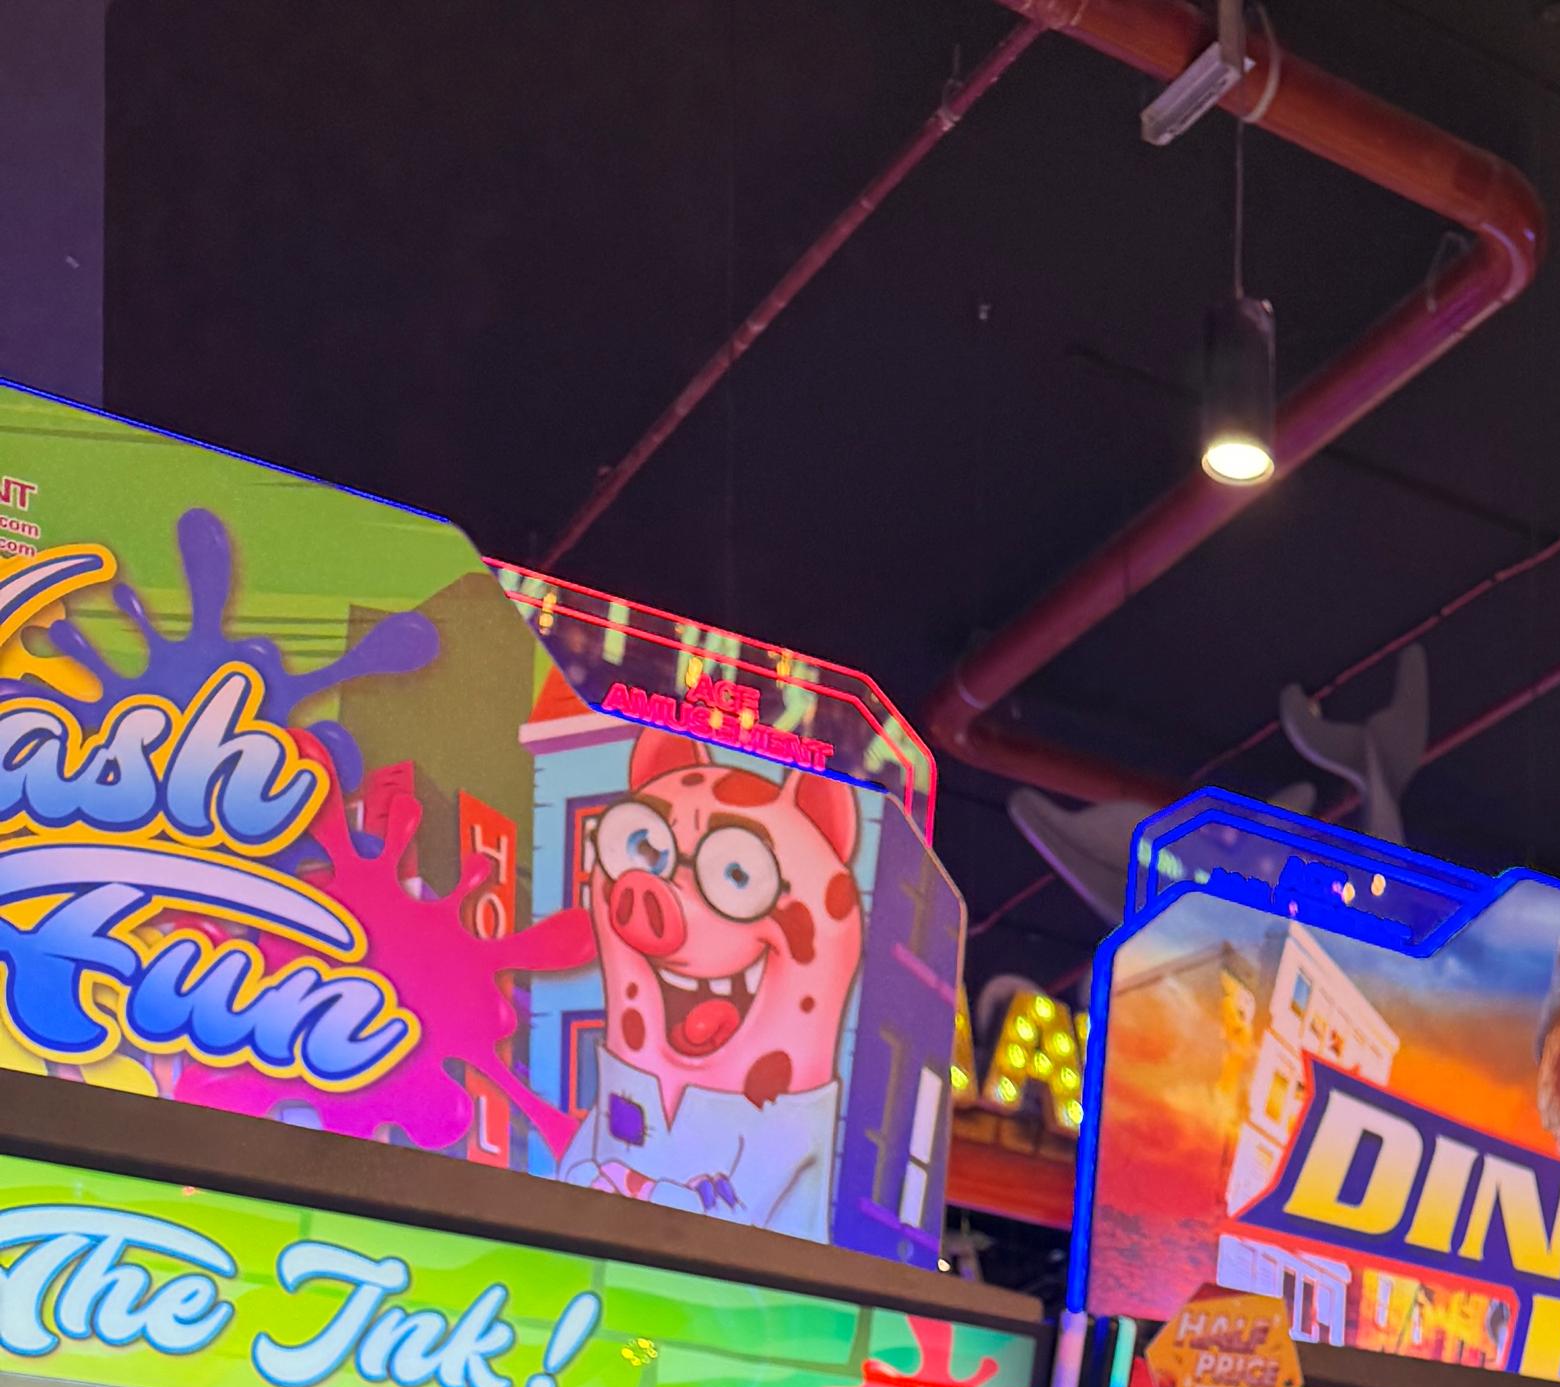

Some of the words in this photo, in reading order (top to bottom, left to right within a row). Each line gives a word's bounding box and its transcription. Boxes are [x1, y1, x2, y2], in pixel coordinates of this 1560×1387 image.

[602, 682, 834, 772] AMUSEMENT
[687, 673, 761, 720] ACE
[0, 883, 416, 1090] Fun
[0, 1206, 236, 1355] The
